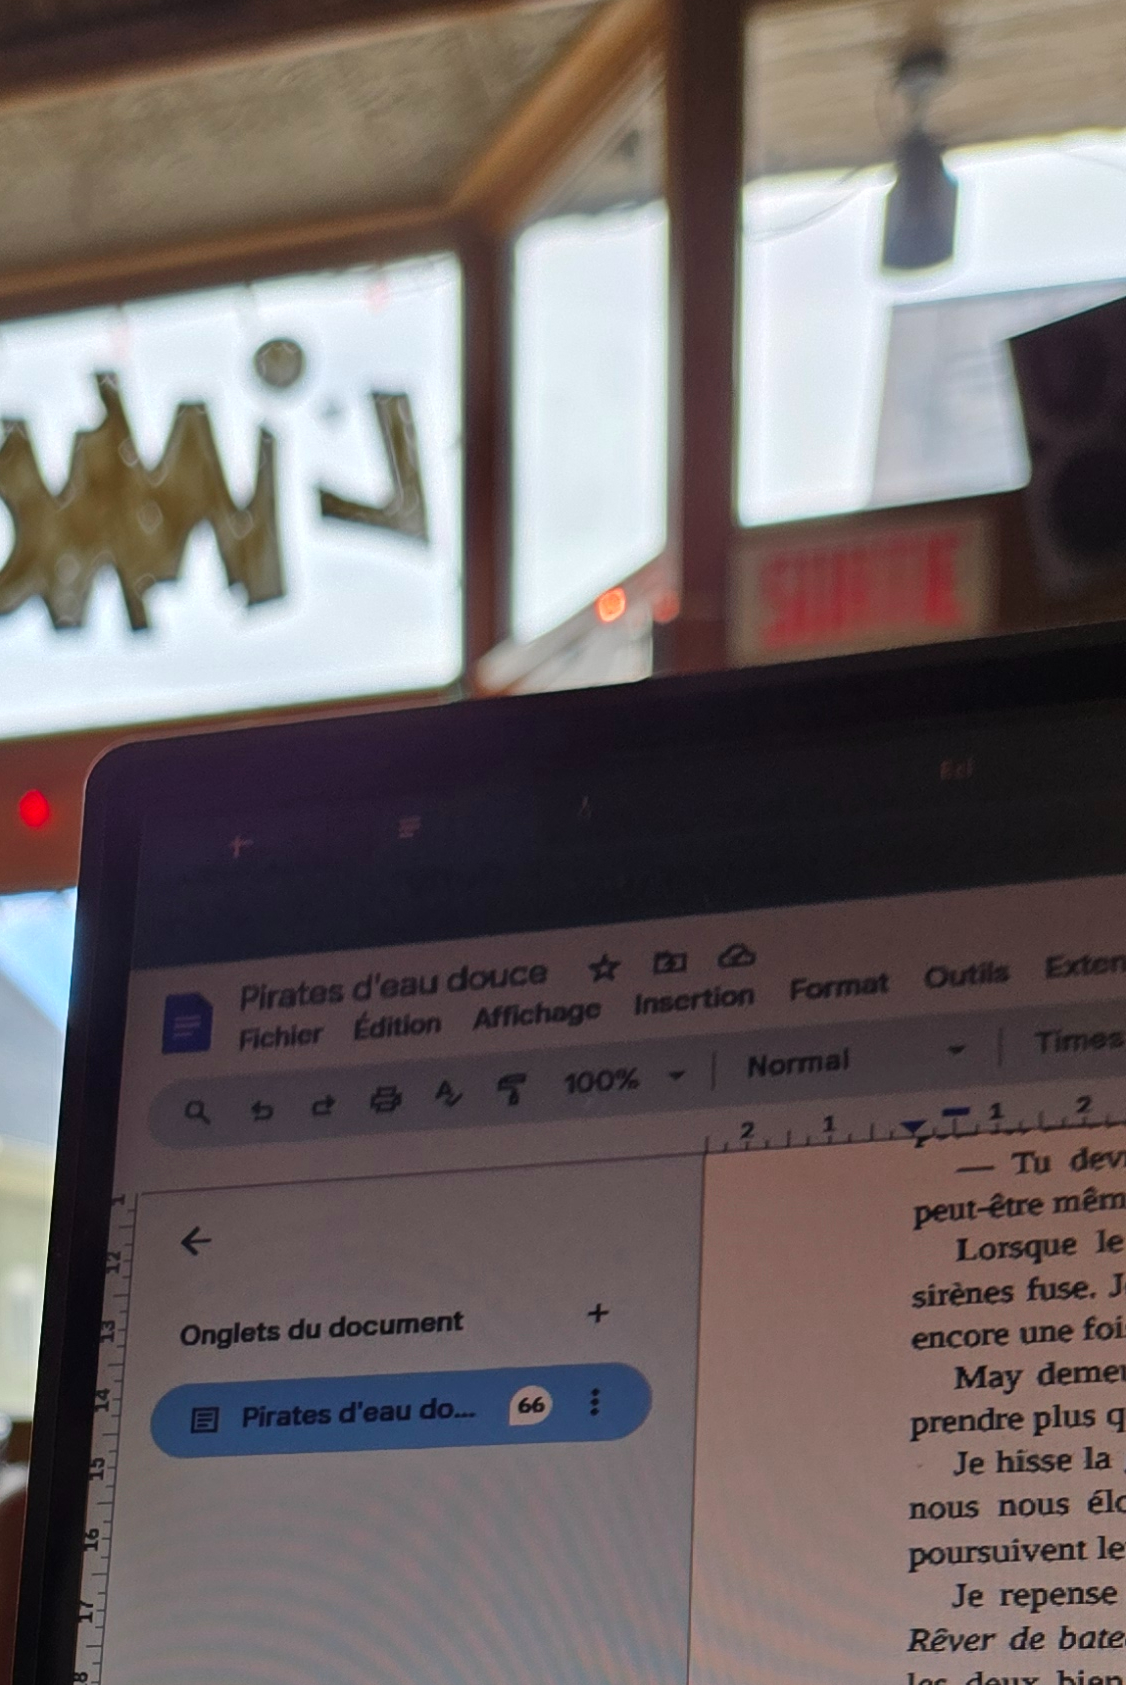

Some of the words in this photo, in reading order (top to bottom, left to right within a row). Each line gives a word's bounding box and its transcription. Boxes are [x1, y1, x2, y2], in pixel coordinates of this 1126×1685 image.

[241, 983, 344, 1011] Pirates
[352, 973, 439, 1003] d'eau
[447, 963, 548, 992] douce
[239, 1024, 324, 1051] Fichier
[354, 1012, 441, 1041] Édition
[473, 999, 602, 1030] Affichage
[635, 986, 755, 1015] Insertion
[790, 973, 889, 1000] Format
[925, 961, 1010, 989] Outils
[565, 1066, 639, 1094] 100%
[748, 1048, 849, 1077] Normal
[1036, 1027, 1125, 1054] Times
[741, 1122, 754, 1138] 2
[824, 1116, 834, 1131] 1
[991, 1103, 1002, 1119] 1
[1077, 1096, 1092, 1113] 2
[1011, 1151, 1050, 1175] Tu
[1070, 1146, 1126, 1172] dev
[913, 1192, 1044, 1230] peut-être
[106, 1249, 121, 1274] 12
[956, 1236, 1076, 1265] Lorsque
[1096, 1229, 1124, 1253] le
[912, 1282, 1014, 1308] sirènes
[1027, 1276, 1096, 1301] fuse.
[1108, 1272, 1126, 1298] J
[101, 1318, 116, 1343] 13
[180, 1322, 280, 1350] Onglets
[288, 1318, 321, 1341] du
[329, 1310, 464, 1338] document
[912, 1327, 1009, 1350] encore
[1020, 1323, 1073, 1344] une
[1083, 1316, 1126, 1340] foi
[954, 1365, 1023, 1394] May
[96, 1388, 110, 1413] 14
[242, 1404, 332, 1428] Pirates
[339, 1402, 413, 1424] d'eau
[517, 1397, 546, 1414] 66
[910, 1407, 1024, 1442] prendre
[1033, 1404, 1095, 1436] plus
[90, 1456, 105, 1481] 15
[953, 1451, 984, 1476] Je
[996, 1450, 1071, 1473] hisse
[1084, 1447, 1111, 1470] la
[909, 1500, 979, 1520] nous
[998, 1496, 1069, 1516] nous
[85, 1527, 99, 1552] 16
[908, 1538, 1088, 1573] poursuivent
[1097, 1536, 1126, 1560] le
[79, 1599, 94, 1623] 17
[952, 1584, 983, 1608] Je
[1000, 1586, 1118, 1613] repense
[907, 1628, 996, 1652] Rêver
[1009, 1626, 1044, 1651] de
[1059, 1625, 1126, 1650] bate
